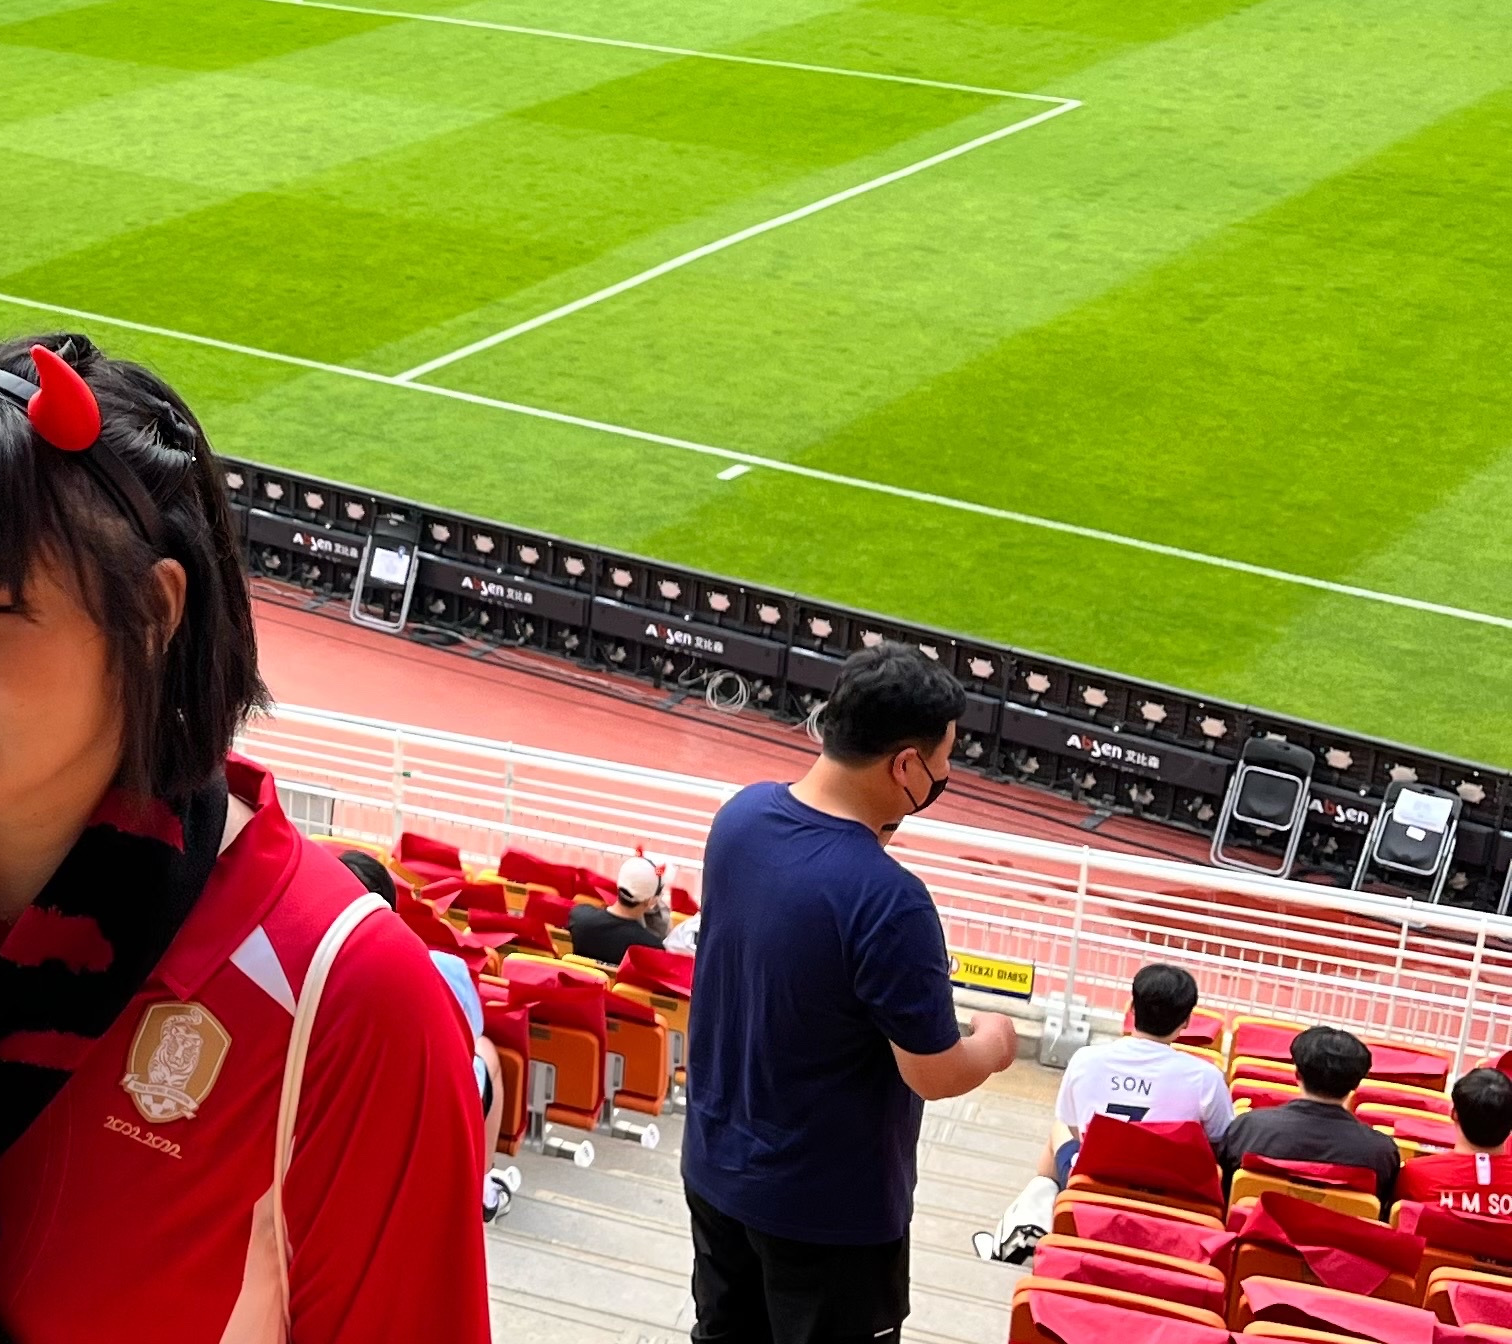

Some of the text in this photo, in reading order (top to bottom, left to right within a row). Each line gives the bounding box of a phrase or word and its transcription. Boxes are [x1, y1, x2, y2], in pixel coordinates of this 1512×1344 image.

[1067, 734, 1123, 759] Absen
[1308, 798, 1369, 825] Absen
[963, 963, 994, 978] 기대지
[1111, 1076, 1152, 1096] SON
[1461, 1192, 1480, 1213] M
